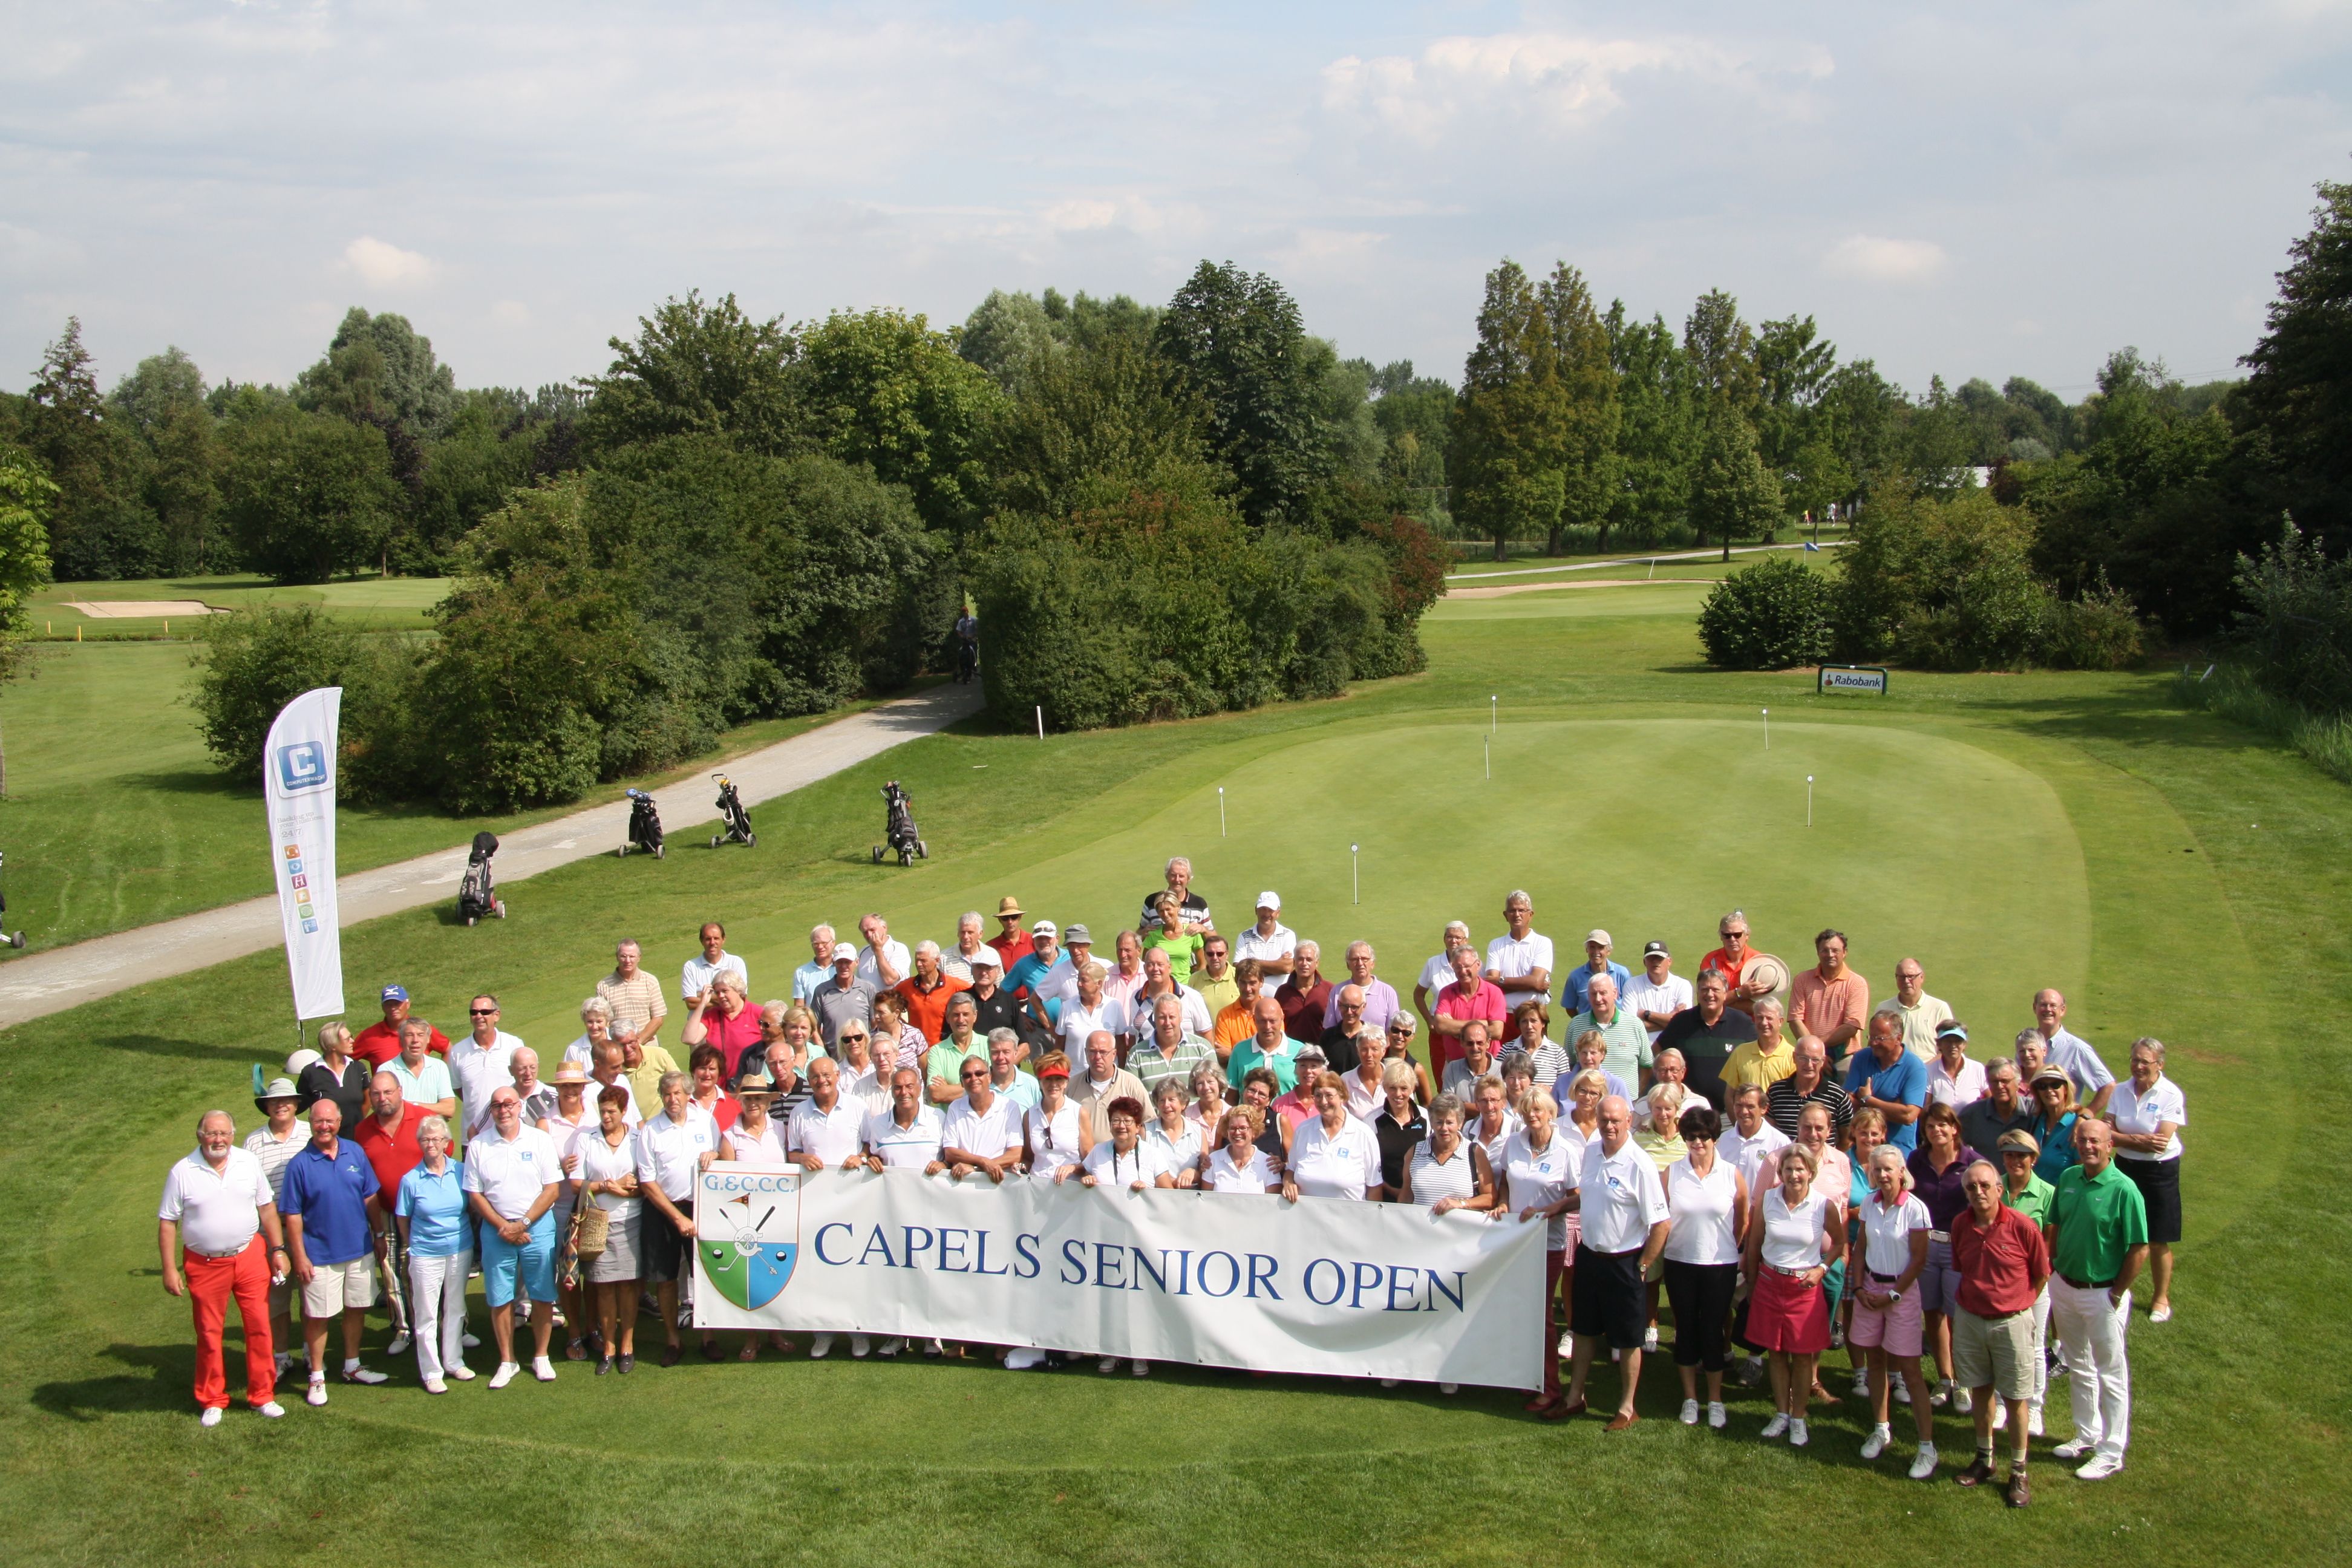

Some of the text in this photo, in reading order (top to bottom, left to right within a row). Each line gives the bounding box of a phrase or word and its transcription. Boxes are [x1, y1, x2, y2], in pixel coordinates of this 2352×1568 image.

[1835, 675, 1880, 687] Rabobank
[289, 746, 316, 777] C
[705, 1175, 794, 1192] G.&C.C.C.
[814, 1222, 1468, 1313] CAPELS SENIOR OPEN
